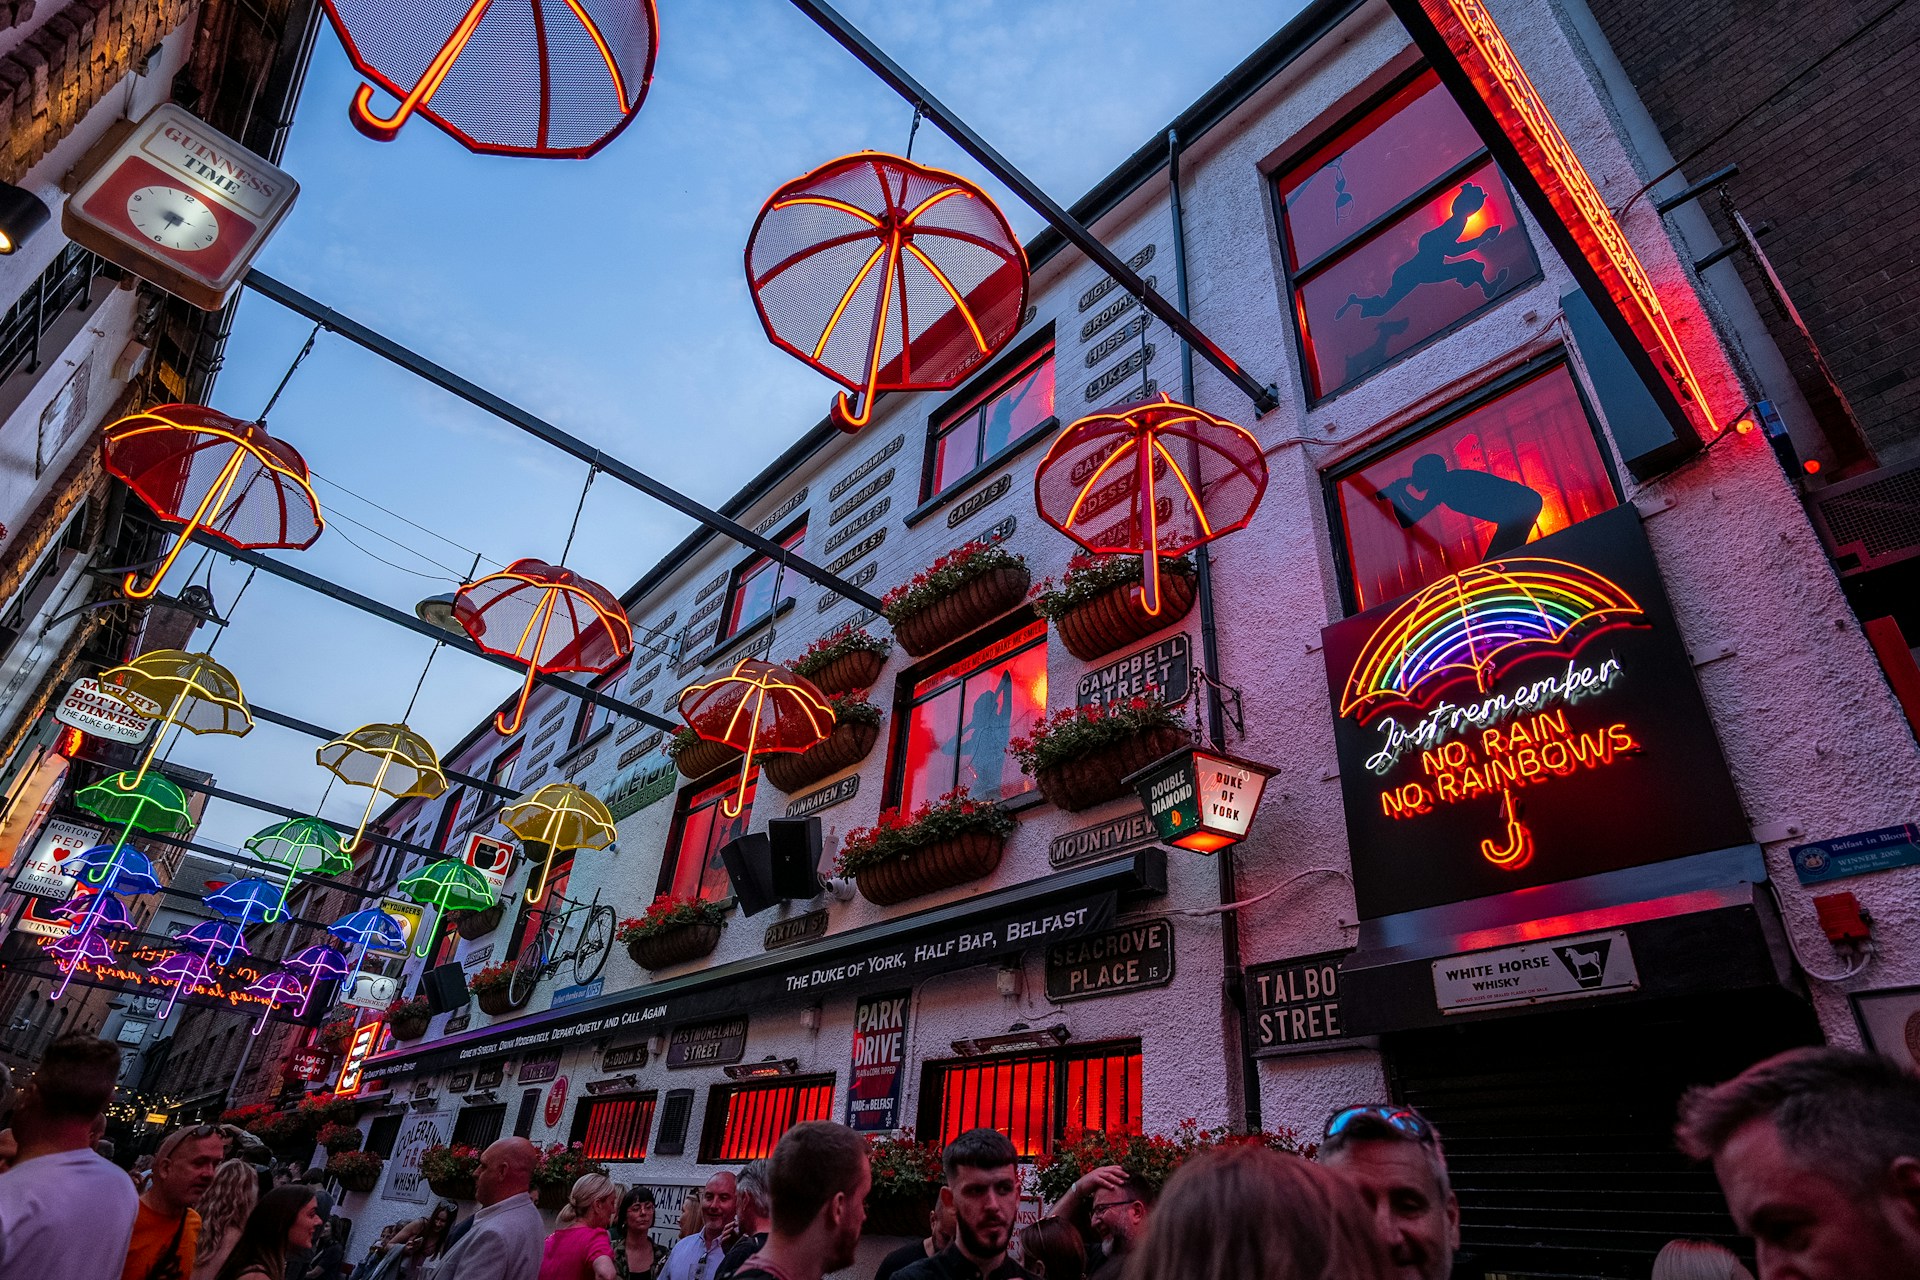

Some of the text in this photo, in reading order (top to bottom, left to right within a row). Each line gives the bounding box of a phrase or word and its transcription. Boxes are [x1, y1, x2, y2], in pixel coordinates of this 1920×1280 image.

[164, 127, 276, 198] GUINNESS
[183, 154, 241, 195] TIME
[133, 194, 143, 203] 9
[183, 195, 196, 205] 12
[153, 234, 162, 243] 6
[206, 234, 214, 243] 3
[949, 489, 988, 523] CAPPY
[825, 510, 874, 550] SACKVILLE
[825, 541, 867, 574] NUGVILLE
[981, 648, 995, 662] AND
[995, 640, 1012, 656] MAKE
[1012, 633, 1023, 646] ME
[1023, 624, 1043, 641] SMILE
[1079, 639, 1184, 696] CAMPBELL
[1090, 662, 1172, 706] STREET
[61, 707, 141, 739] THE DUKE OF YORK
[64, 698, 149, 732] GUINNESS
[1366, 659, 1621, 770] Just remember
[1421, 709, 1566, 775] NO RAIN
[1216, 772, 1243, 790] DUKE
[1380, 723, 1632, 817] NO RAINBOWS
[1150, 769, 1186, 801] DOUBLE
[1221, 790, 1235, 803] OF
[787, 790, 838, 816] DUNRAVEN
[1151, 783, 1193, 817] DIAMOND
[1212, 803, 1240, 822] YORK
[49, 822, 99, 840] MORTON'S
[51, 834, 84, 849] RED
[1831, 838, 1864, 852] Belfast
[1866, 836, 1877, 845] in
[1837, 852, 1877, 867] WINNER
[14, 880, 67, 899] GUINNESS
[27, 873, 63, 887] BOTTLED
[26, 921, 71, 937] UINNESS
[765, 919, 807, 944] PAXTON
[786, 907, 1089, 992] THE DUKE OF YORK, HALF BAP, BELFAST
[1070, 959, 1159, 993] PLACE 15
[1445, 955, 1551, 982] WHITE HORSE
[1257, 963, 1342, 1006] TALBO
[1471, 976, 1521, 992] WHISKY
[514, 1031, 550, 1049] MODERATELY,
[551, 1025, 576, 1040] DEPART
[575, 1020, 603, 1037] QUIETLY
[603, 1016, 619, 1030] AND
[621, 1012, 641, 1027] CALL
[640, 1004, 668, 1022] AGAIN
[857, 997, 906, 1035] PARK
[1259, 1003, 1341, 1044] STREE
[294, 1054, 326, 1066] LADIES
[683, 1042, 721, 1061] STREET
[854, 1031, 902, 1068] DRIVE
[293, 1064, 320, 1076] ROOM
[851, 1100, 866, 1112] MADE
[870, 1097, 894, 1111] BELFAST
